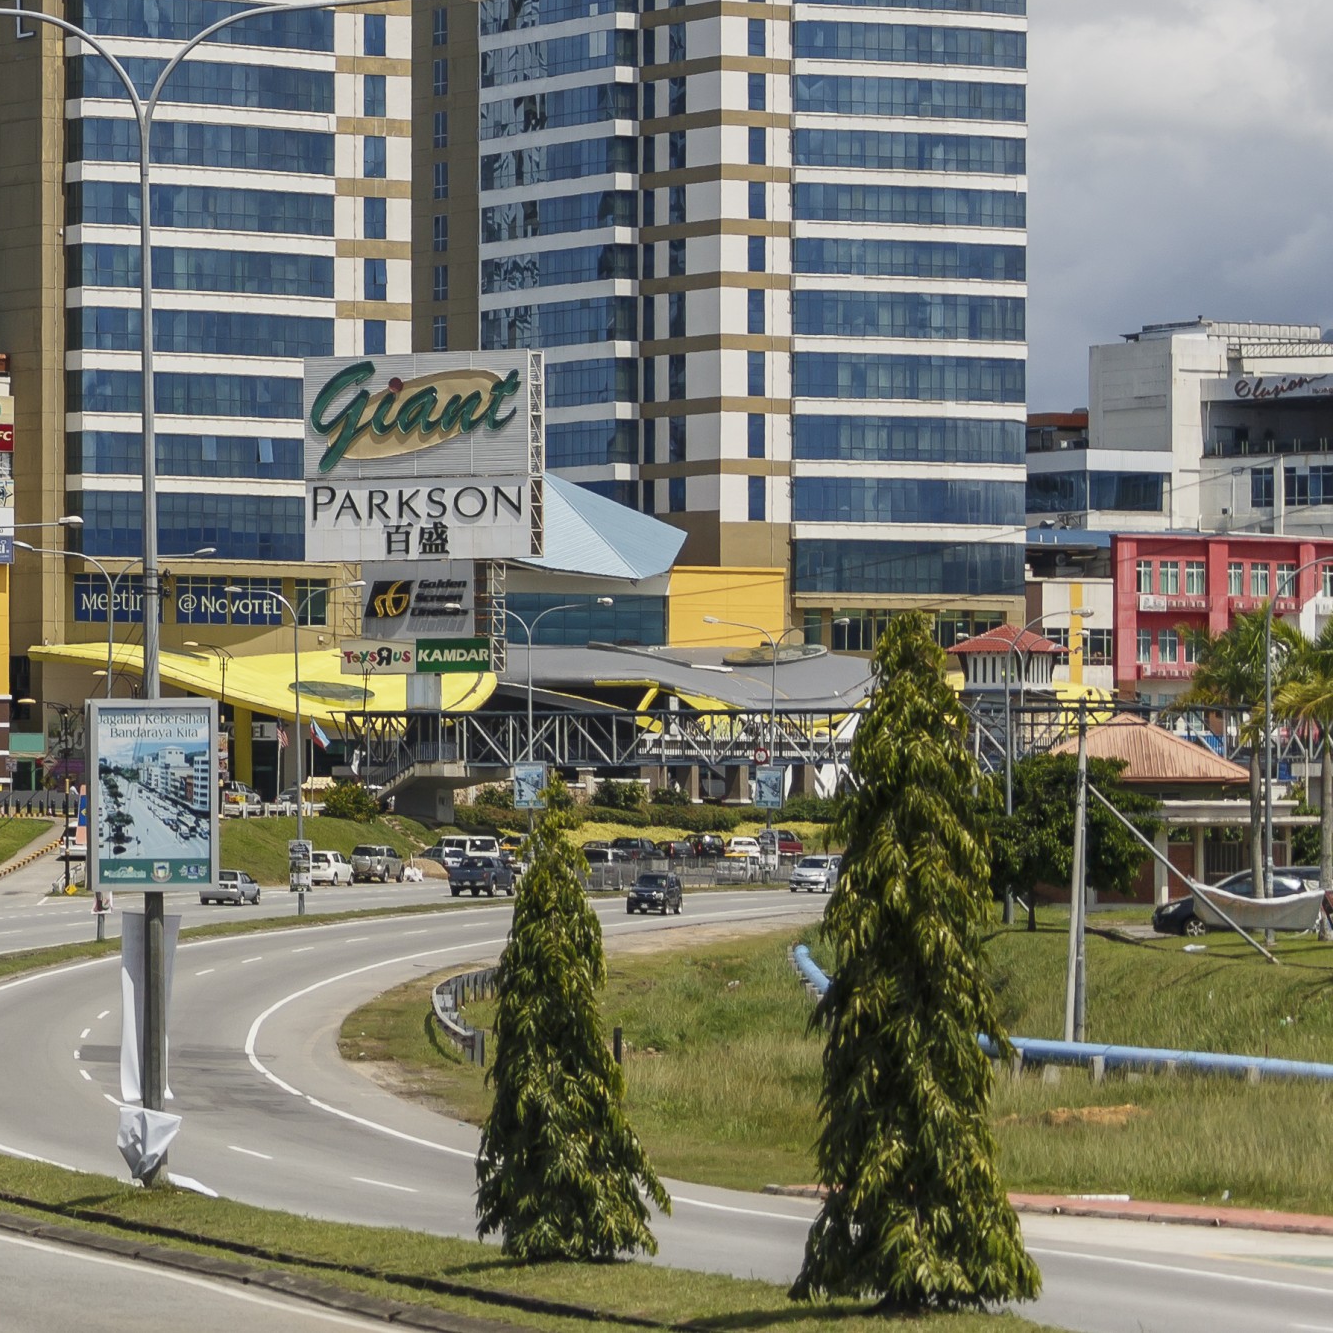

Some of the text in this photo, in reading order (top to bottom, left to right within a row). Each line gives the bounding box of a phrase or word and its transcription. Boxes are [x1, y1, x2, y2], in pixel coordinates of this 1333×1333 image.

[310, 361, 521, 473] Giant
[313, 486, 522, 521] PARKSON
[384, 521, 450, 555] 百盛
[418, 579, 467, 589] Golden
[201, 595, 282, 615] NOVOTEL
[417, 649, 489, 662] KAMDAR
[98, 712, 210, 726] Jagalah Kebersihan
[110, 727, 198, 740] Bandaraya Kita
